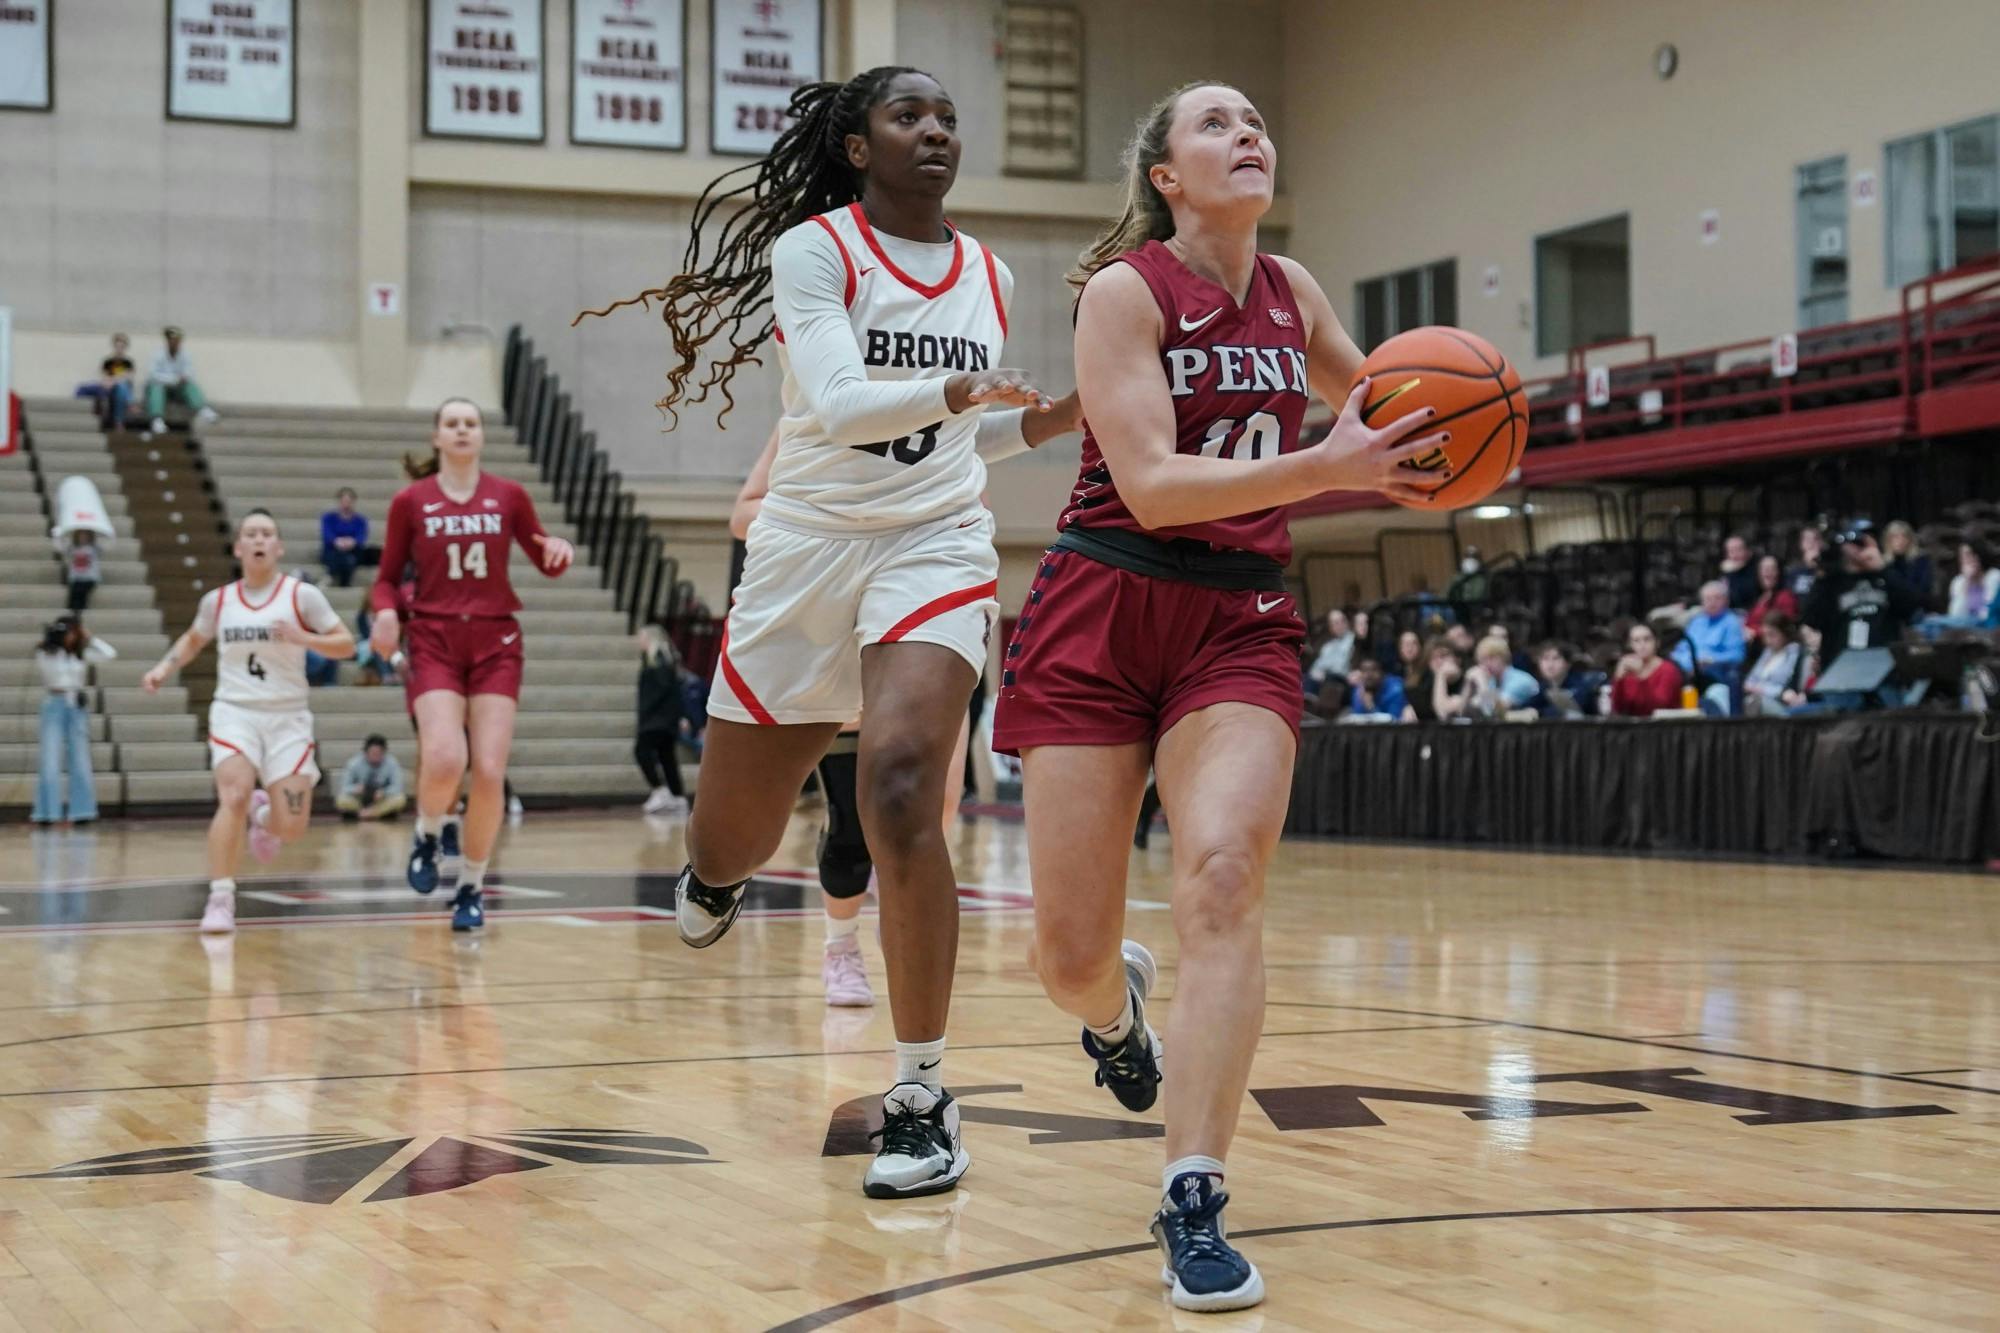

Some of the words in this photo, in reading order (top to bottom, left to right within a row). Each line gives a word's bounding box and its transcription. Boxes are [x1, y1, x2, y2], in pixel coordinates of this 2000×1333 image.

[455, 29, 515, 51] NCAA
[599, 39, 657, 61] NCAA
[743, 52, 790, 69] NCAA
[863, 328, 989, 372] BROWN
[1165, 344, 1309, 397] PENN
[423, 513, 502, 538] PENN
[446, 541, 488, 580] 14
[248, 652, 266, 681] 4
